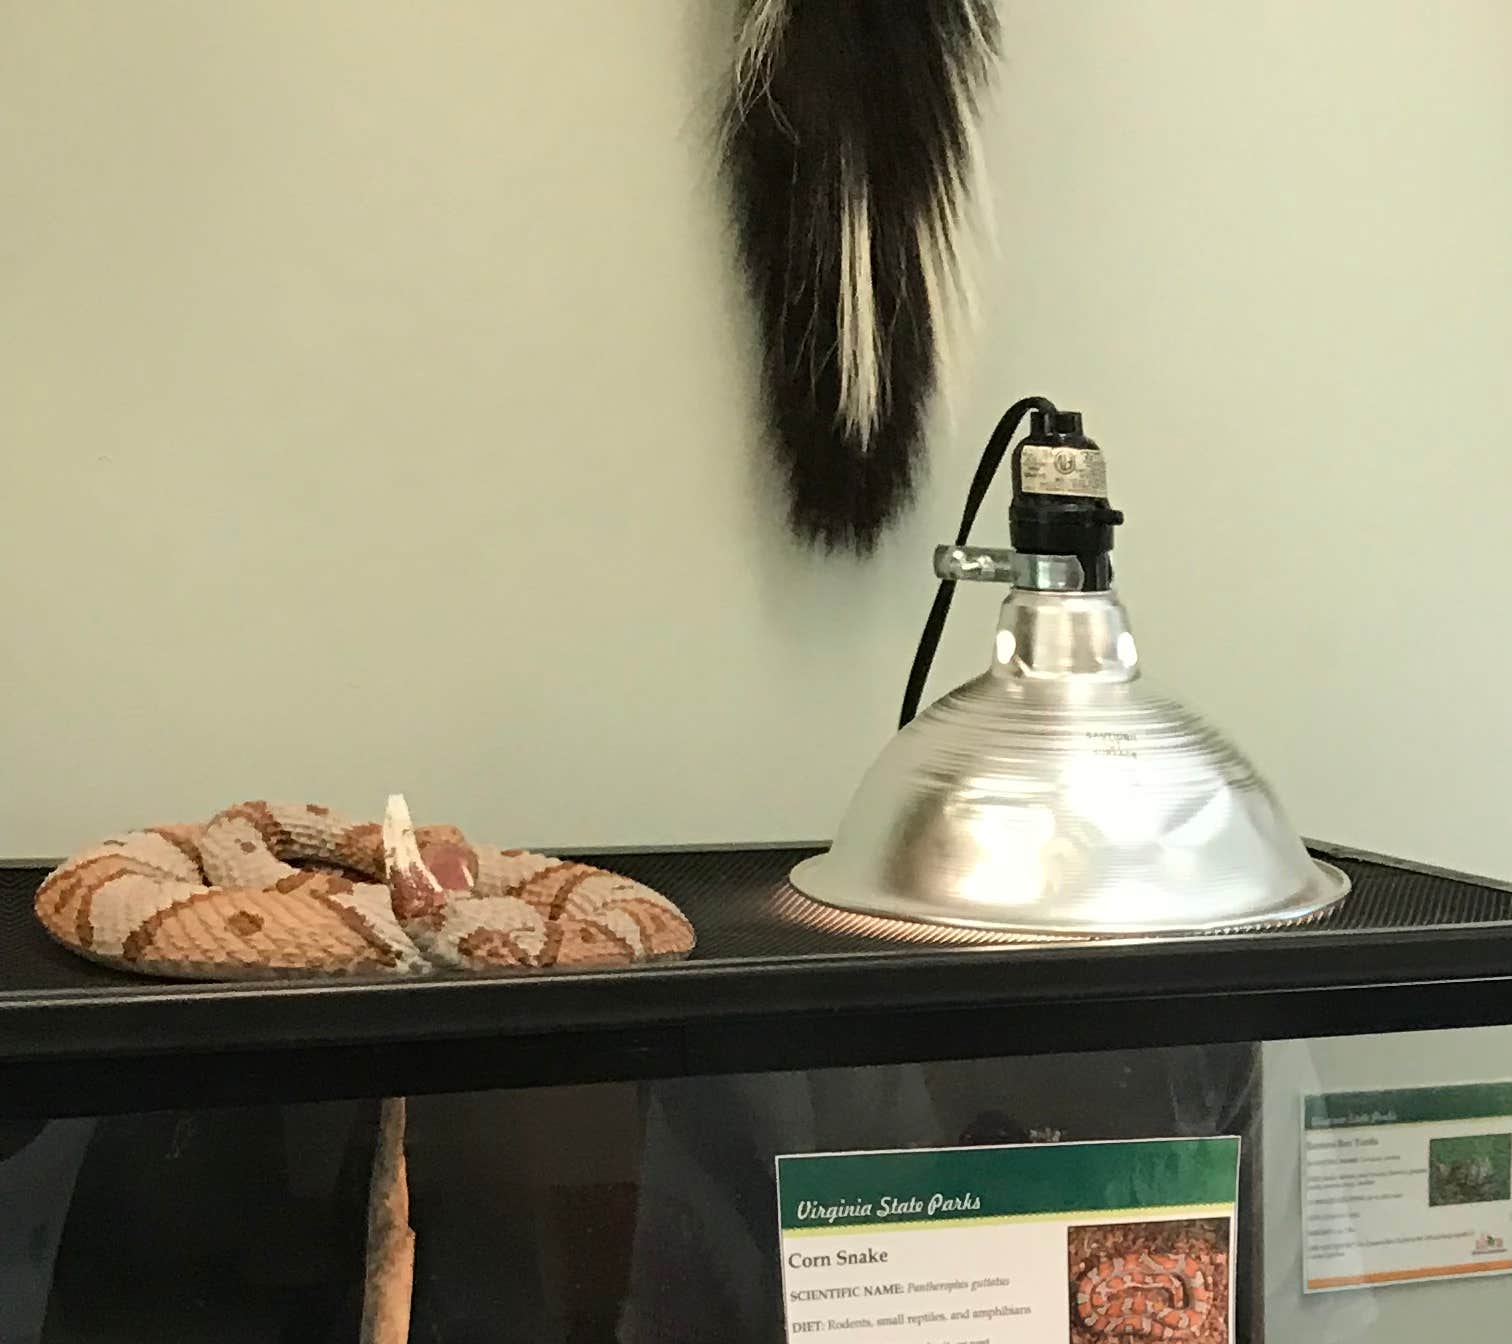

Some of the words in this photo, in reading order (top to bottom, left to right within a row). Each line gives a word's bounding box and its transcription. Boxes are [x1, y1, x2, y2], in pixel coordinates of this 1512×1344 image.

[797, 1199, 872, 1224] Virginia
[876, 1196, 923, 1218] State
[927, 1193, 981, 1216] Parks
[788, 1252, 831, 1269] Corn
[836, 1248, 889, 1267] Snake
[790, 1286, 861, 1301] SCIENTIFIC
[863, 1283, 904, 1296] NAME:
[792, 1321, 825, 1334] DIET:
[828, 1317, 873, 1331] Rodents,
[877, 1314, 905, 1326] small
[950, 1308, 970, 1321] and
[972, 1305, 1032, 1321] amphibians
